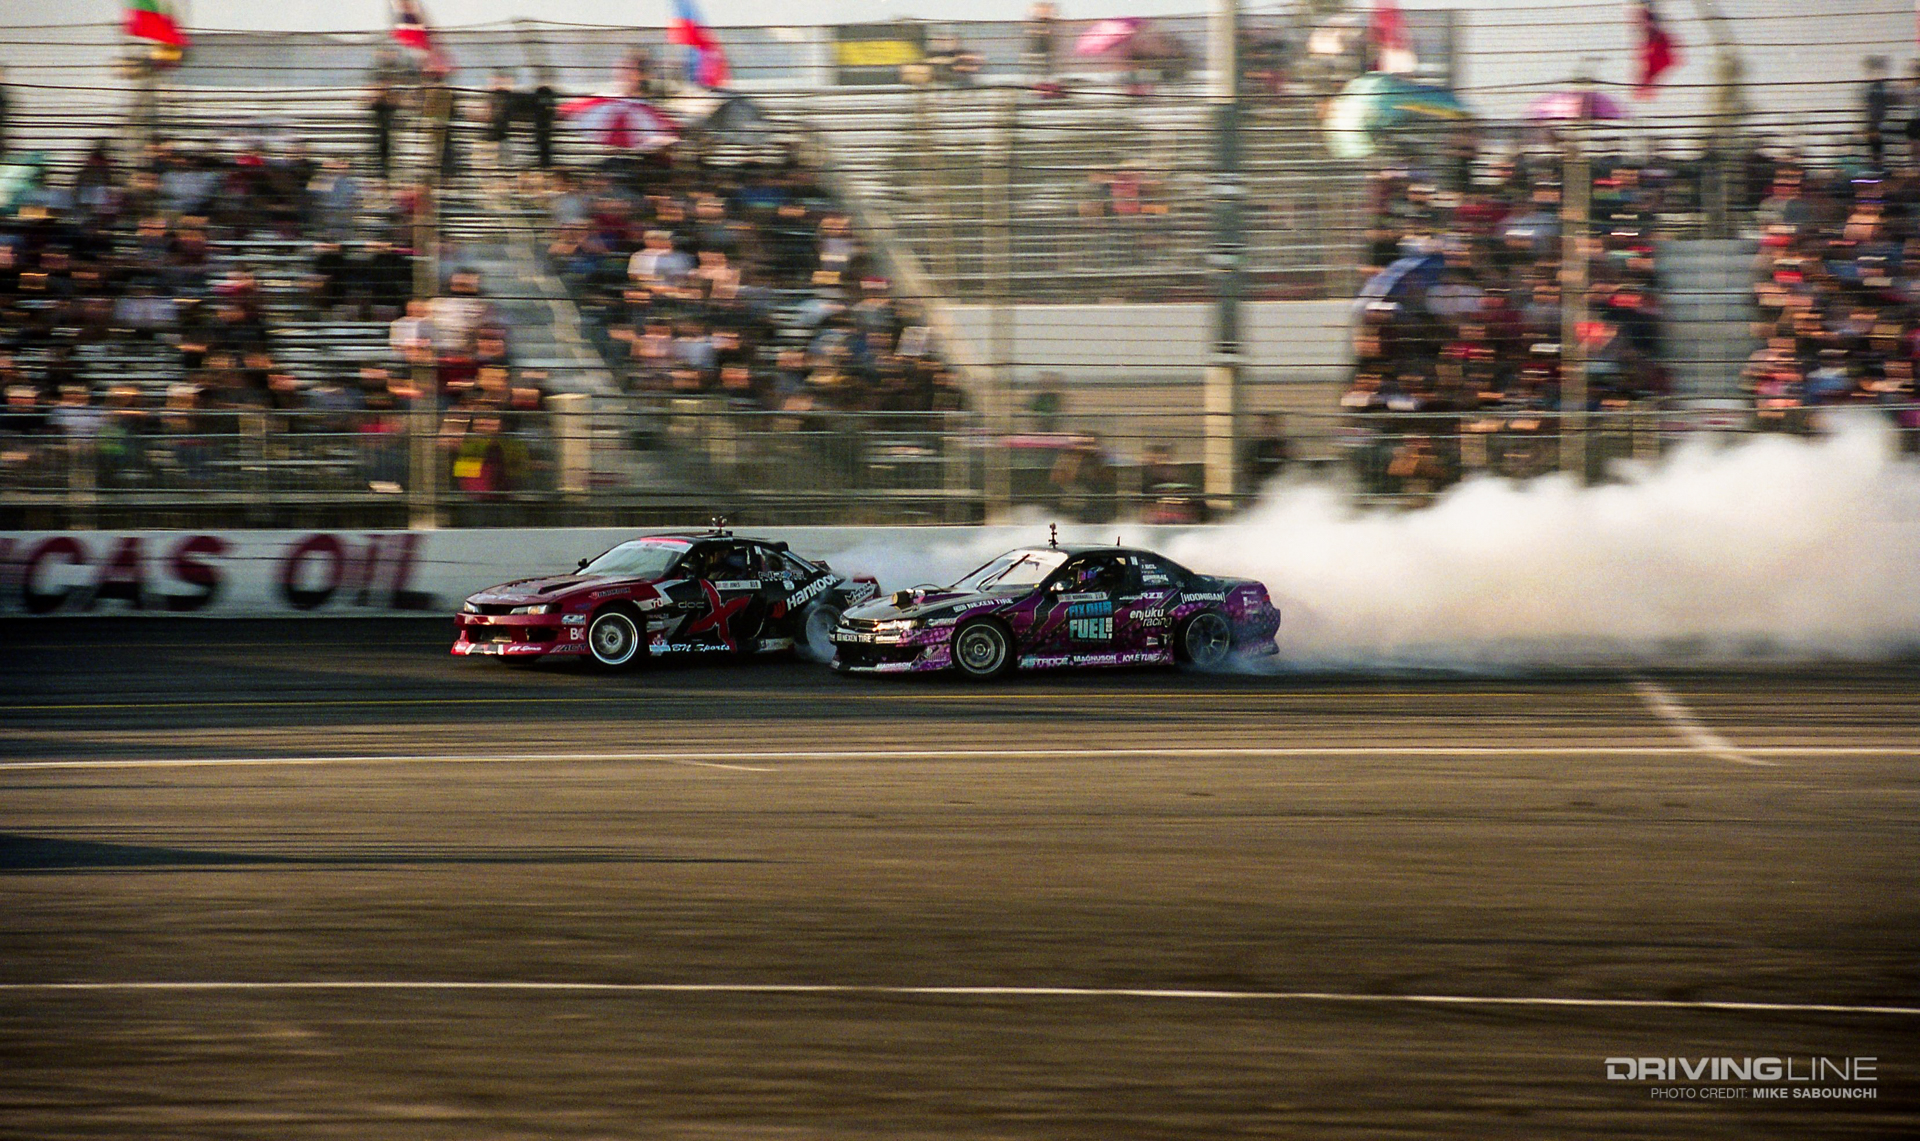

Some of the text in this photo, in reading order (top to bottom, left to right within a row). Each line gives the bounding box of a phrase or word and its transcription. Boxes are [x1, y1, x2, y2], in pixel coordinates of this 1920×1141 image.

[0, 535, 224, 613] CAS
[1129, 607, 1164, 621] enjuku
[1069, 617, 1113, 640] FUEL!
[1142, 617, 1173, 628] racing
[694, 643, 731, 652] Sports
